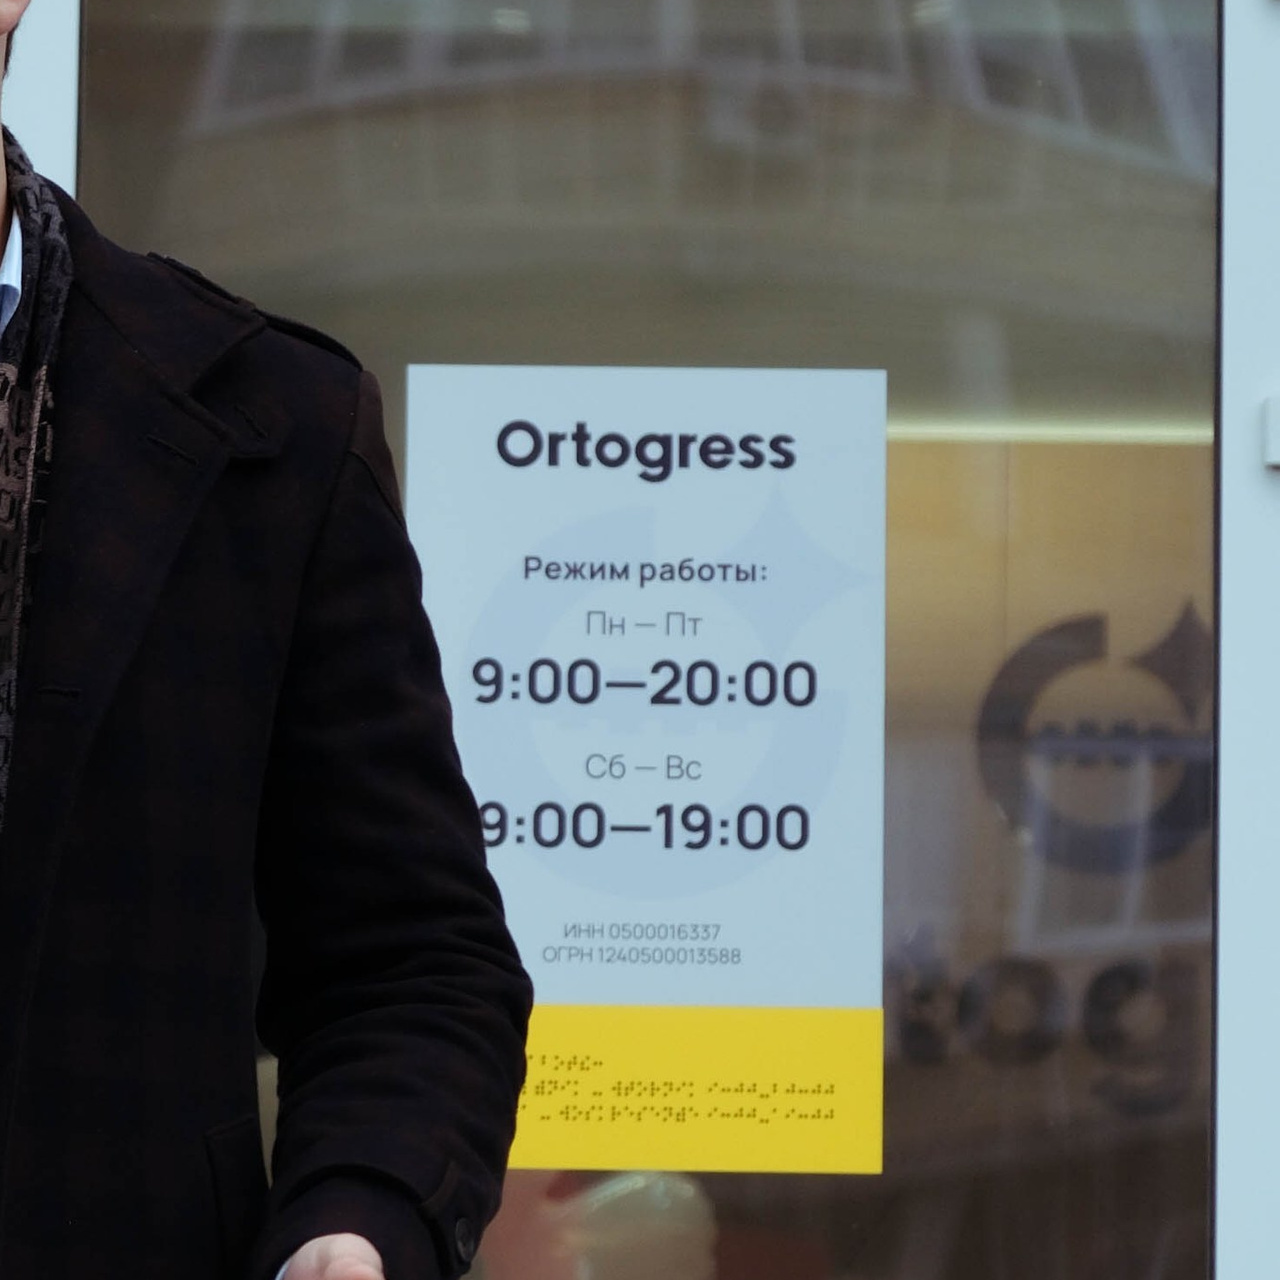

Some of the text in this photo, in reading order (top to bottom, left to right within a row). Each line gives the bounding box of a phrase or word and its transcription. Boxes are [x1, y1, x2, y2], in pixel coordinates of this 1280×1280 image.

[496, 419, 798, 484] Ortogress
[523, 556, 768, 588] Режим работы:
[585, 610, 626, 636] Пн
[665, 611, 704, 637] Пт
[584, 753, 627, 780] Сб
[665, 754, 703, 781] Вс
[563, 923, 721, 941] ИНН 0500016337
[541, 945, 742, 966] ОГРН 1240500013588
